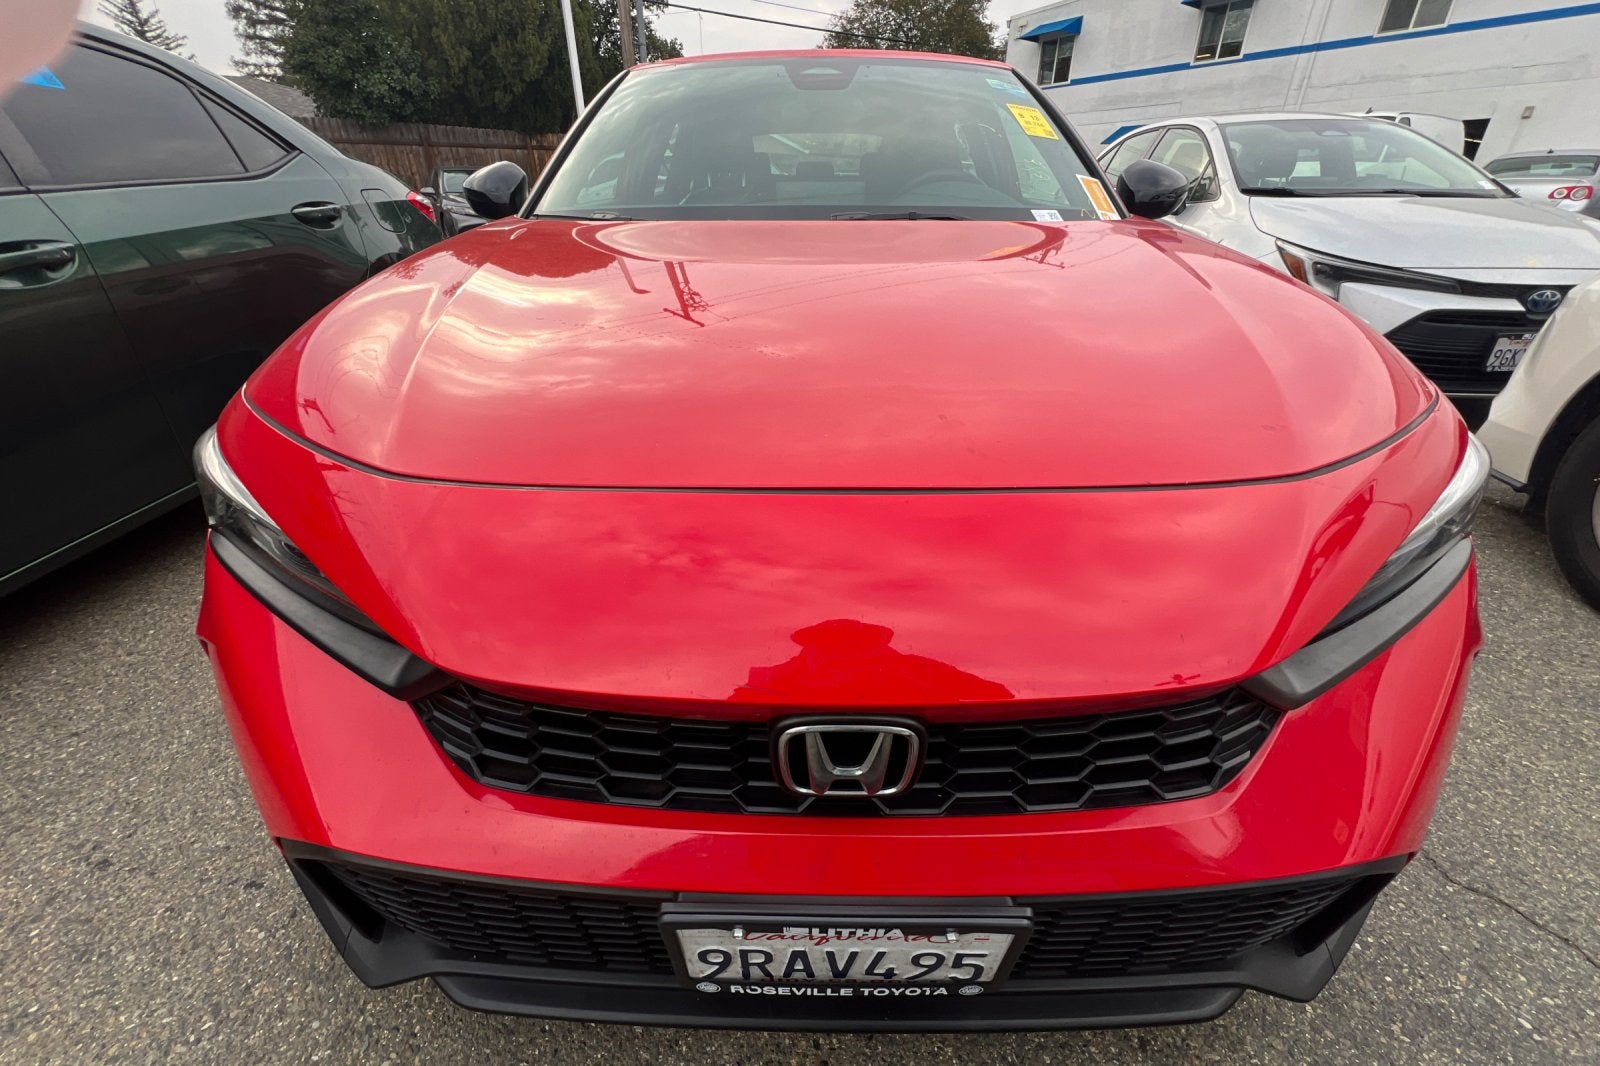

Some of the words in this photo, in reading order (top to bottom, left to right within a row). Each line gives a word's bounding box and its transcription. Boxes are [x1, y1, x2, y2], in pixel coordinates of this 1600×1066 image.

[697, 948, 988, 982] 9RAV495
[730, 985, 853, 996] ROSEVILLE
[860, 987, 948, 996] TOYOTA
